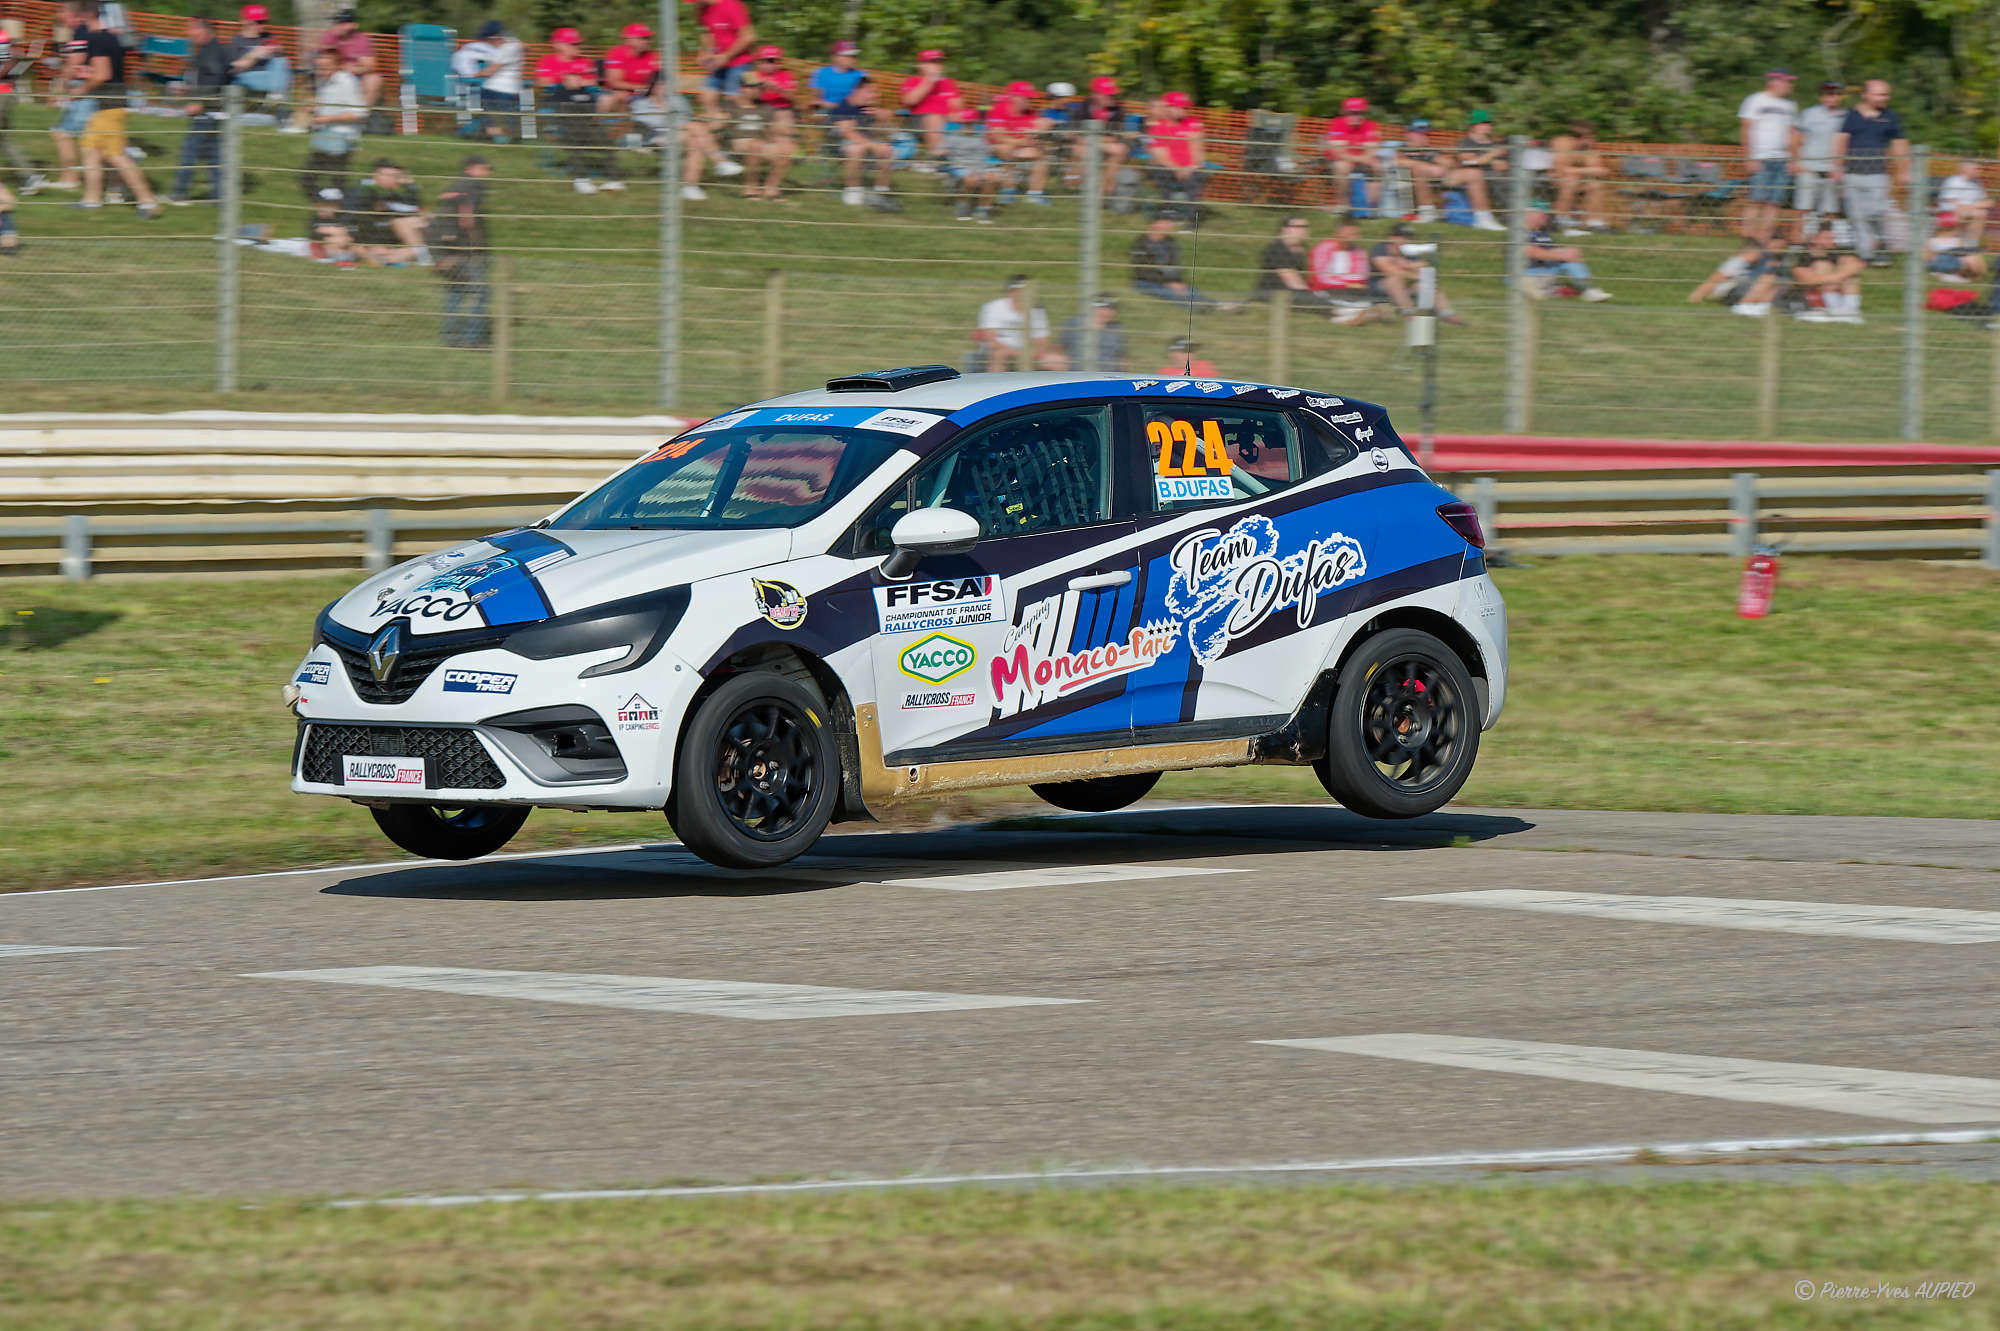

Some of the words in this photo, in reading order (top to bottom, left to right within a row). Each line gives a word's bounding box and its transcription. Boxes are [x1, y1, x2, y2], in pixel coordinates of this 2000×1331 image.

[774, 413, 834, 422] DUFAS
[1146, 419, 1234, 477] 224
[1158, 479, 1230, 498] B.DUFAS
[1172, 530, 1253, 590] Team
[886, 578, 982, 608] FFSA
[1228, 542, 1354, 636] Dufas
[369, 594, 474, 621] YACCO
[885, 609, 944, 622] CHAMPIONNAT
[946, 607, 957, 615] DE
[959, 603, 992, 614] FRANCE
[884, 617, 954, 633] RALLYCROSS
[955, 612, 992, 625] JUNIOR
[1003, 602, 1050, 653] Camping
[908, 648, 968, 669] YACCO
[991, 630, 1171, 702] Monaco-Parc
[445, 671, 516, 686] COOPER
[475, 683, 511, 692] TIRES
[905, 692, 951, 706] RALLYCROSS
[951, 695, 975, 705] FRANCE
[349, 762, 397, 779] RALLYCROSS
[399, 770, 422, 783] FRANCE
